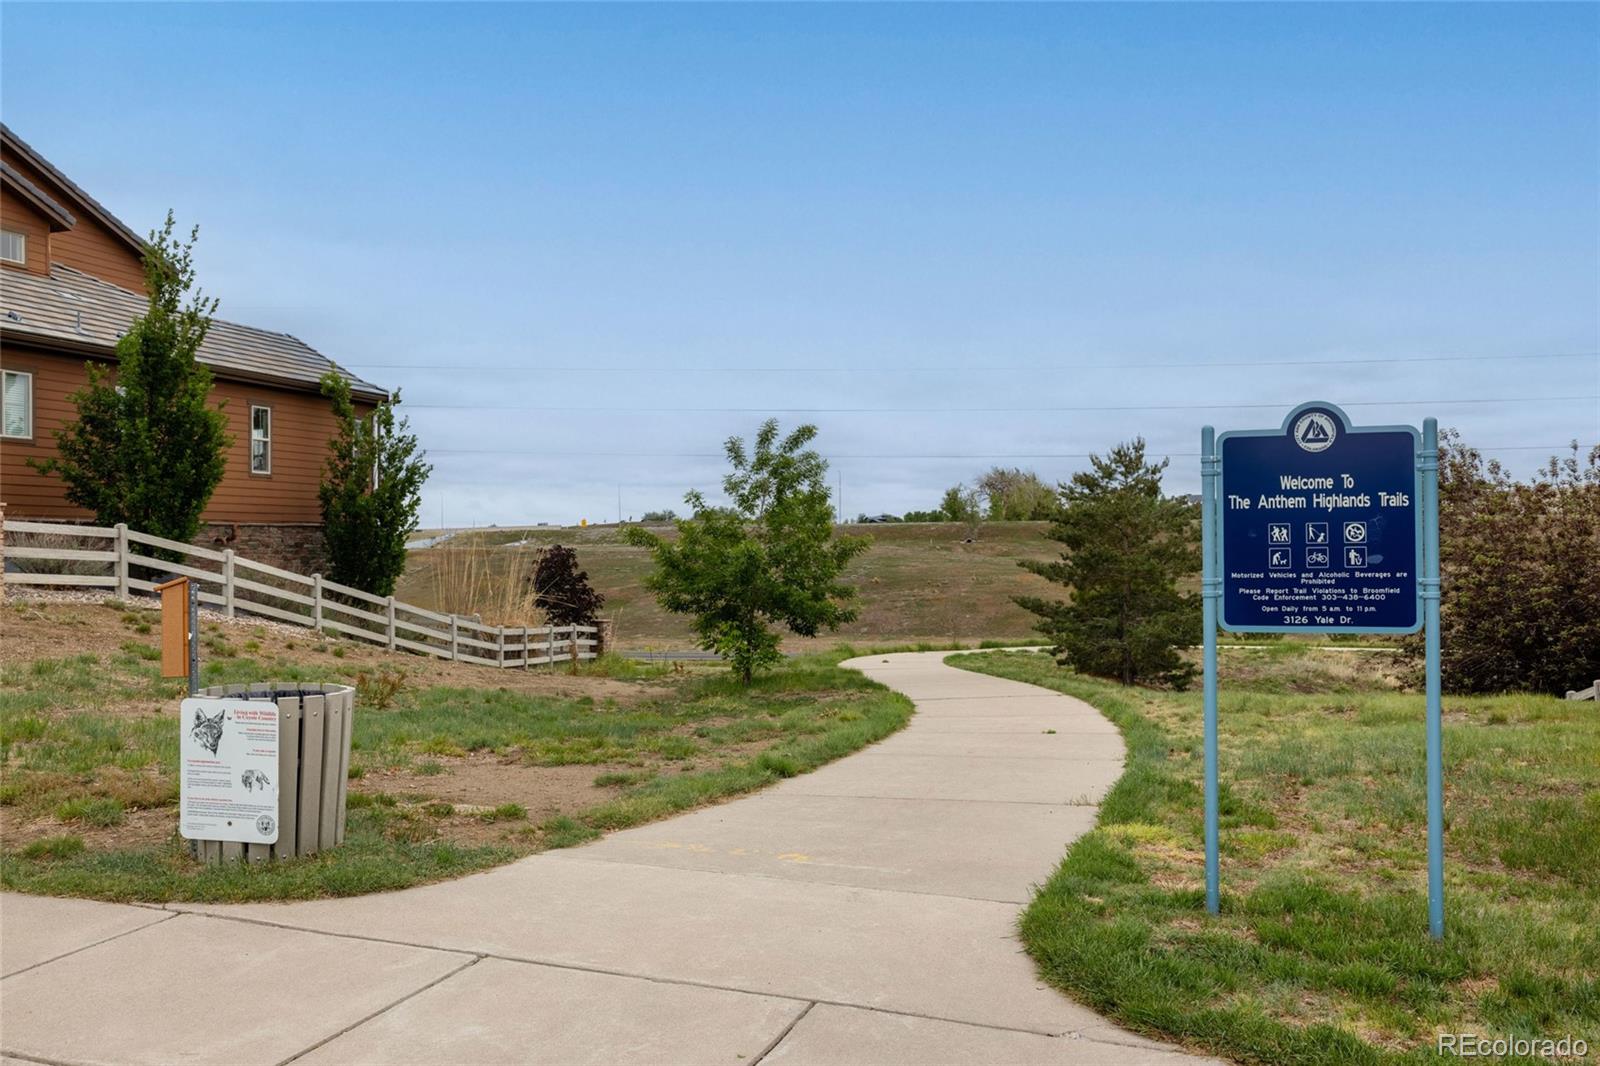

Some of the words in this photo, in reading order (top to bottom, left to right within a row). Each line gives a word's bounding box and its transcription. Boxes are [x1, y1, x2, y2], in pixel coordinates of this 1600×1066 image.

[1280, 475, 1334, 490] Welcome
[1341, 474, 1354, 489] To
[1228, 495, 1251, 510] The
[1258, 494, 1306, 509] Anthem
[1313, 493, 1371, 512] Highlands
[1378, 492, 1409, 507] Trails
[1355, 571, 1391, 579] Beverages
[1265, 587, 1289, 595] Report
[1261, 605, 1279, 613] Open
[1281, 605, 1299, 613] Daily
[1283, 616, 1309, 624] 3126
[1314, 615, 1335, 624] Yale
[1339, 615, 1354, 624] Dr.
